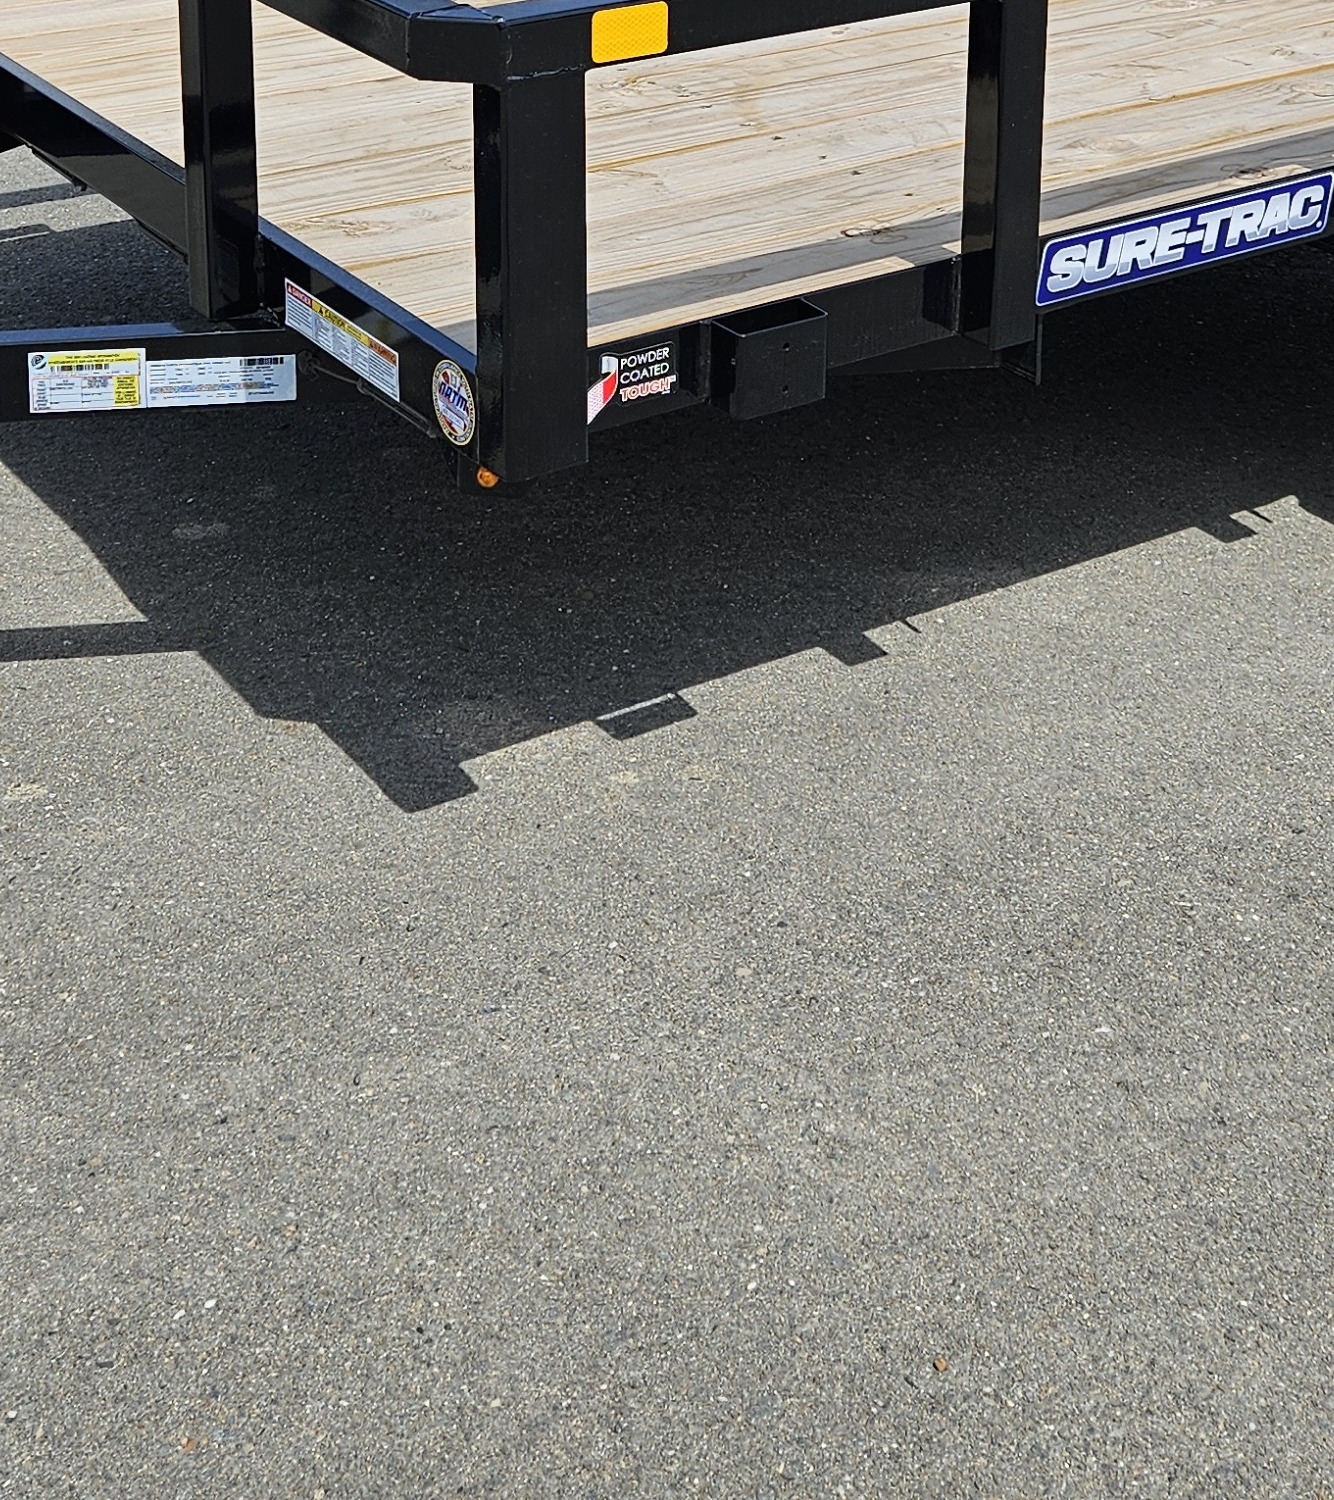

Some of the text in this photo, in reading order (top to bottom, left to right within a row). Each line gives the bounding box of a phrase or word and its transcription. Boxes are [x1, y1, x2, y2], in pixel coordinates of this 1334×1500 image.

[1046, 184, 1326, 293] SURE-TRAC
[620, 346, 670, 370] POWDER
[620, 363, 670, 384] COATED
[619, 377, 671, 402] TOUGH
